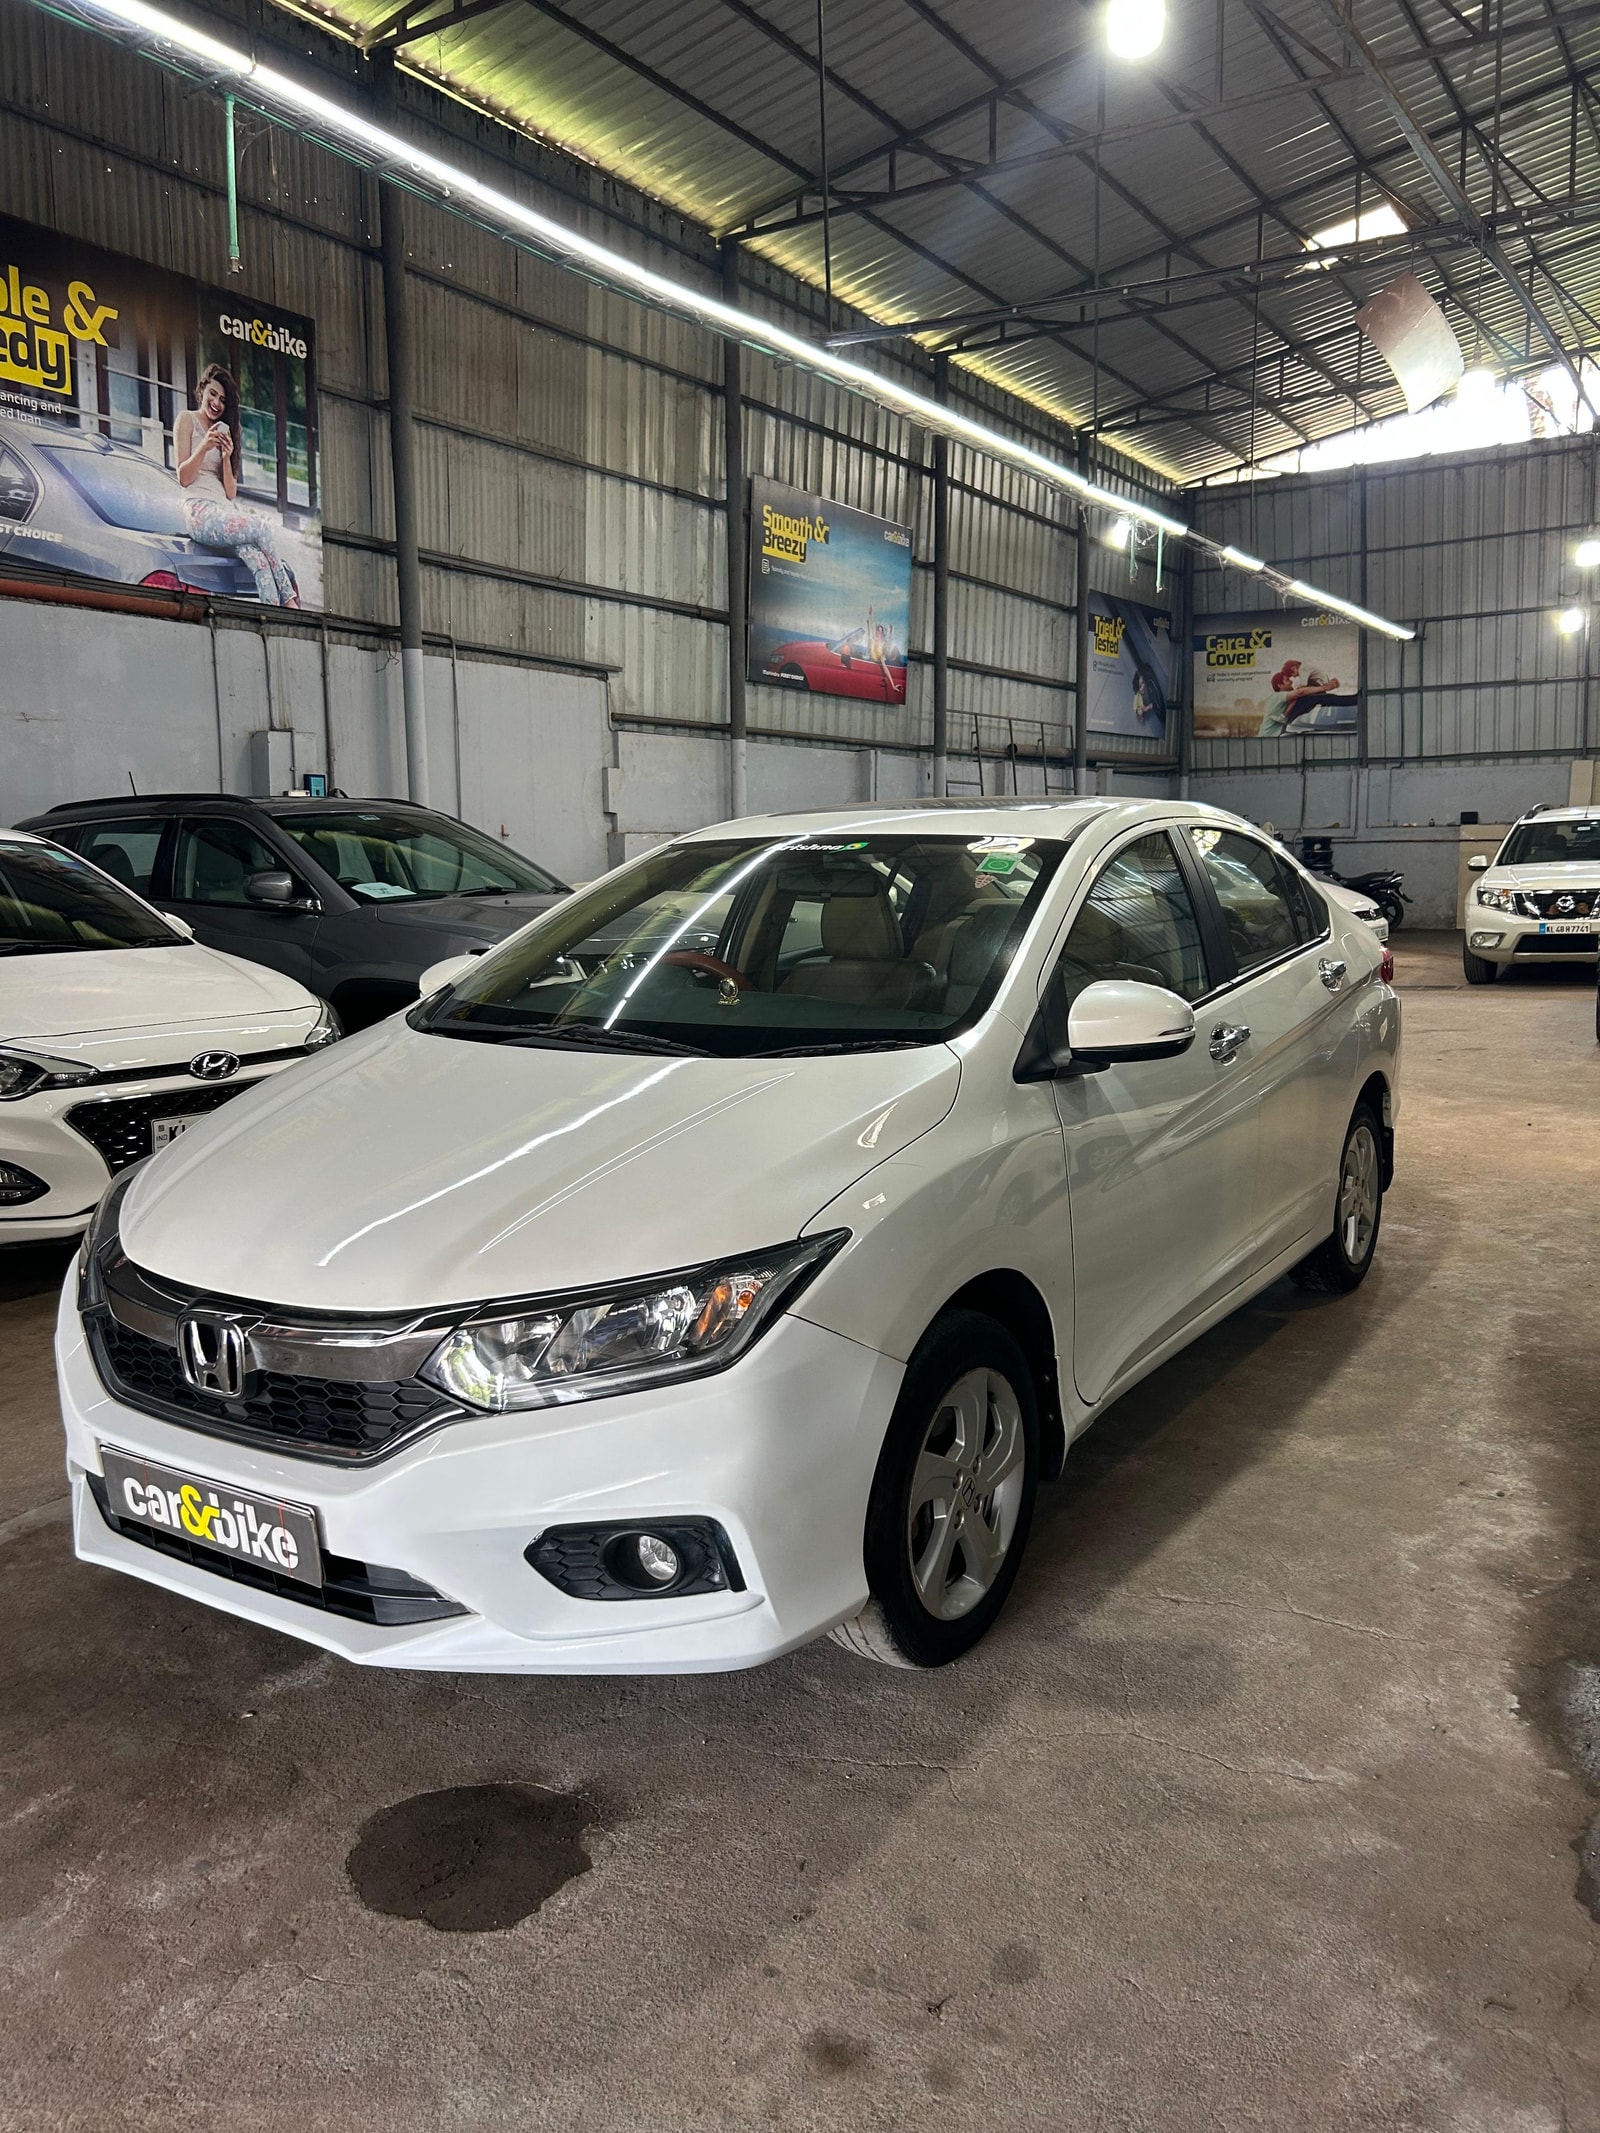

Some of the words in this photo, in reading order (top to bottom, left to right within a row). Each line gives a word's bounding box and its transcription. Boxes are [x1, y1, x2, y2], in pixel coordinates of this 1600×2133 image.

[63, 280, 119, 347] &
[219, 314, 308, 360] car&bike
[16, 409, 42, 426] loan
[40, 401, 62, 415] and
[14, 526, 63, 543] CHOICE
[763, 504, 813, 540] Smooth
[814, 515, 830, 544] &
[764, 526, 807, 563] Breezy
[1094, 615, 1115, 639] Tried
[1095, 634, 1119, 655] Tested
[1206, 635, 1246, 652] Care
[1249, 627, 1272, 650] &
[1206, 650, 1254, 667] Cover
[123, 1476, 299, 1569] car&bike
